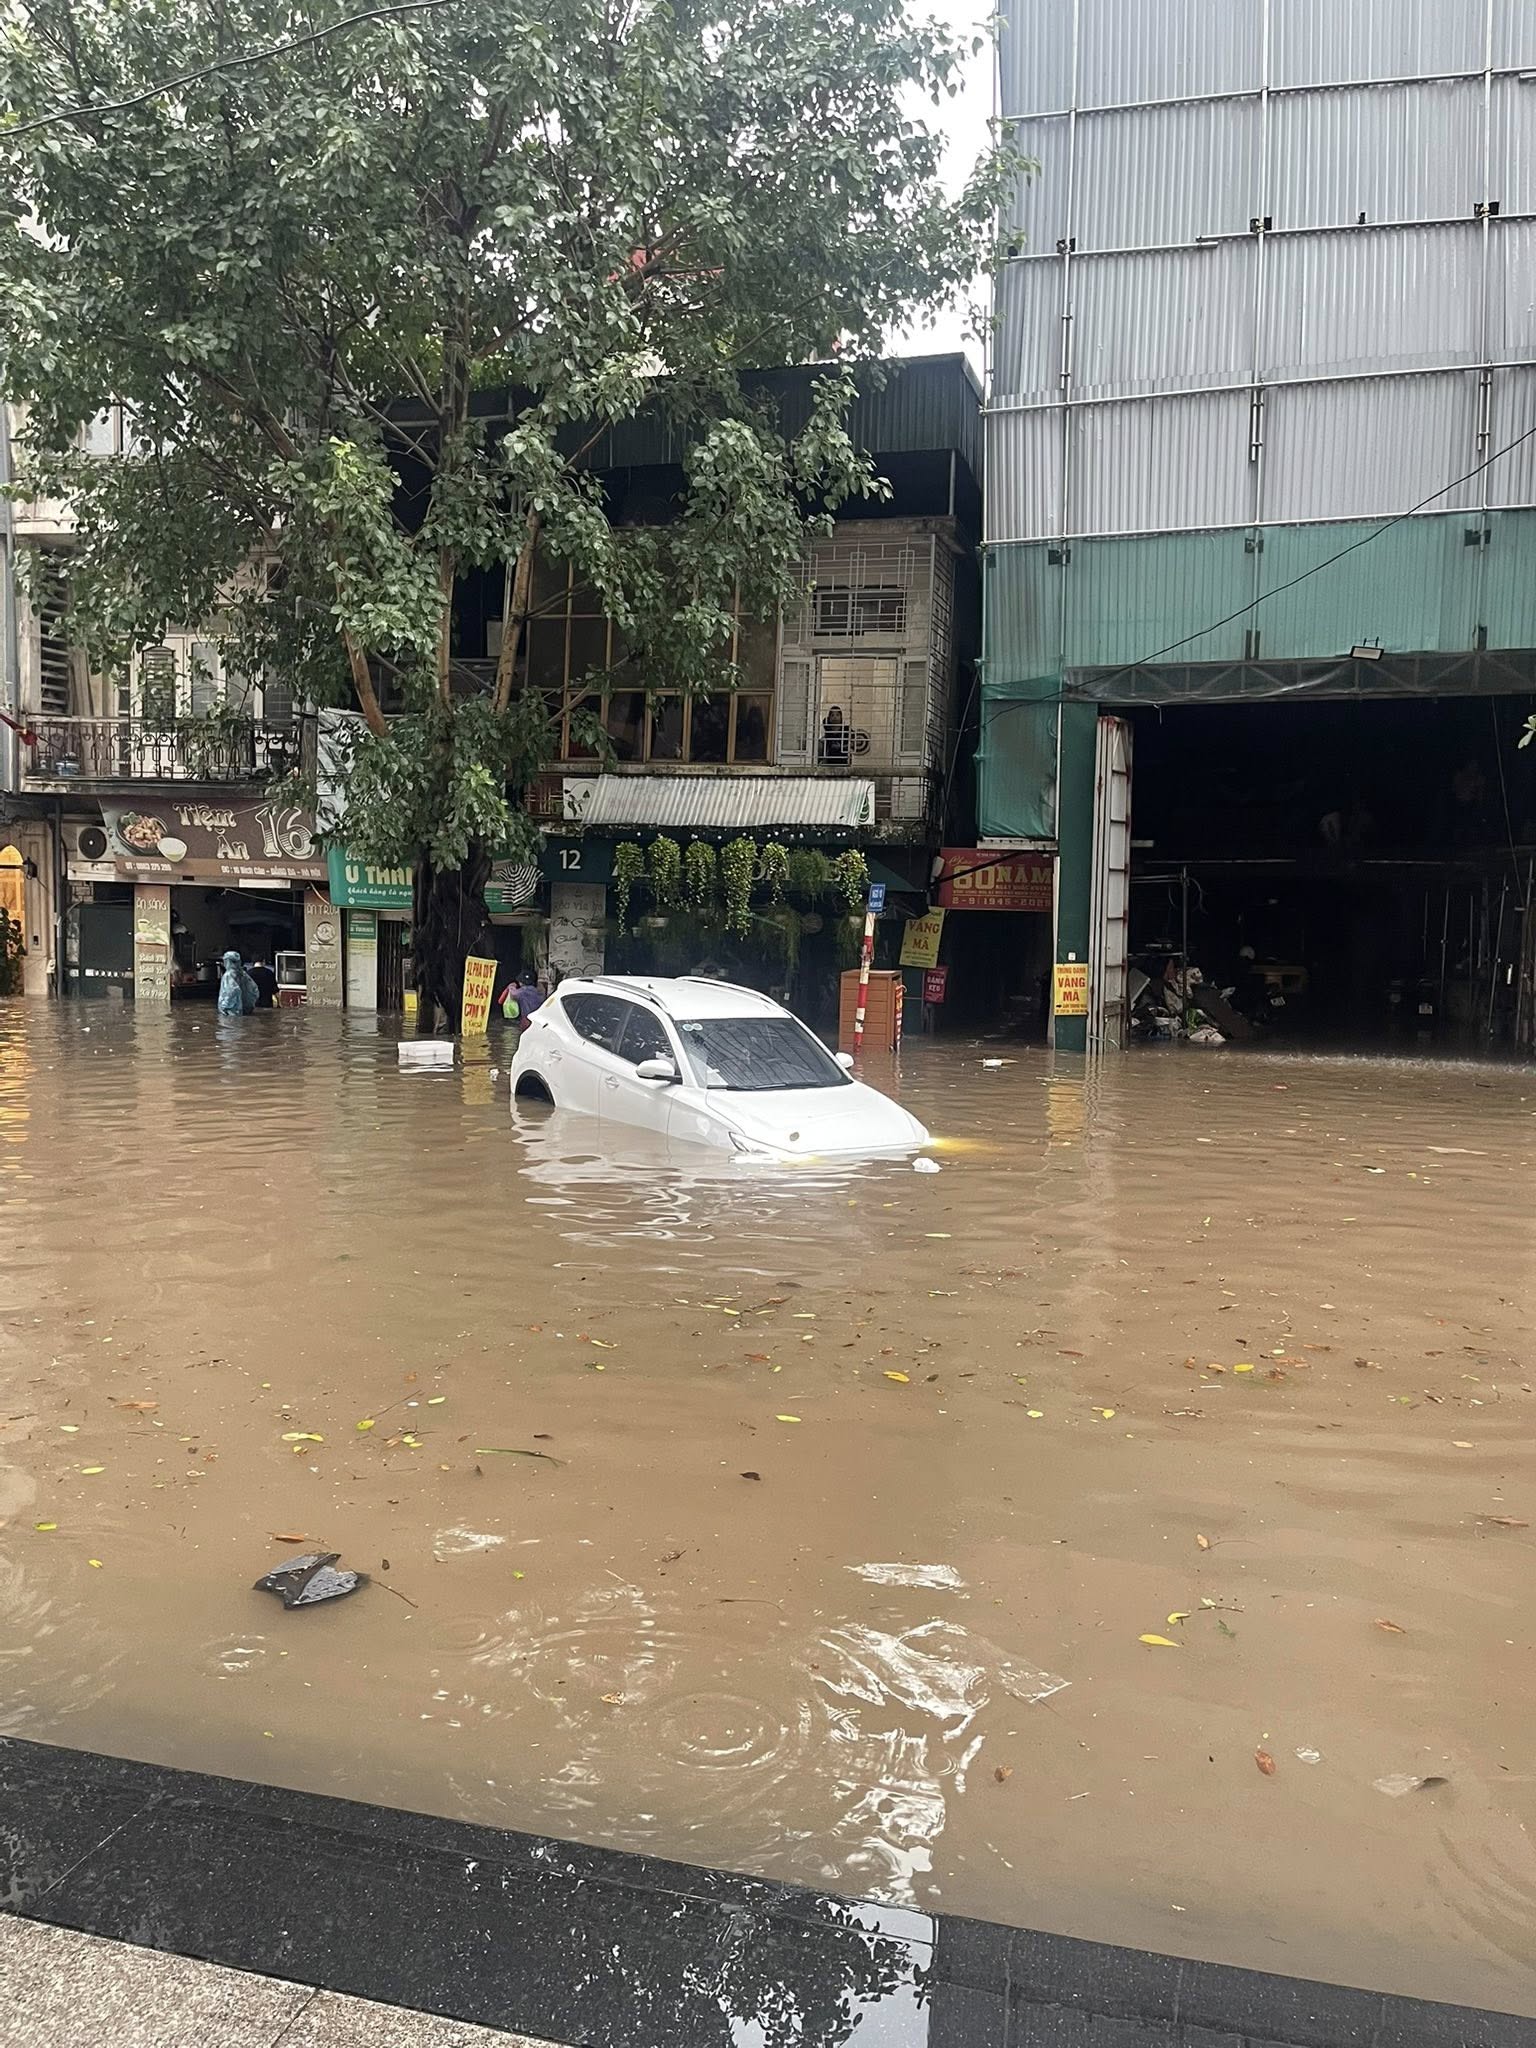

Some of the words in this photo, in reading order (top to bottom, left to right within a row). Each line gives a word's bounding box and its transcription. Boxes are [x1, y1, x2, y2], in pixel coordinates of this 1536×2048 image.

[172, 803, 237, 832] Tiệm
[255, 806, 316, 860] 16
[216, 827, 250, 861] Ăn
[559, 849, 581, 870] 12
[912, 937, 929, 951] MÃ
[1057, 975, 1086, 988] VÀNG
[1063, 989, 1080, 1002] MÃ
